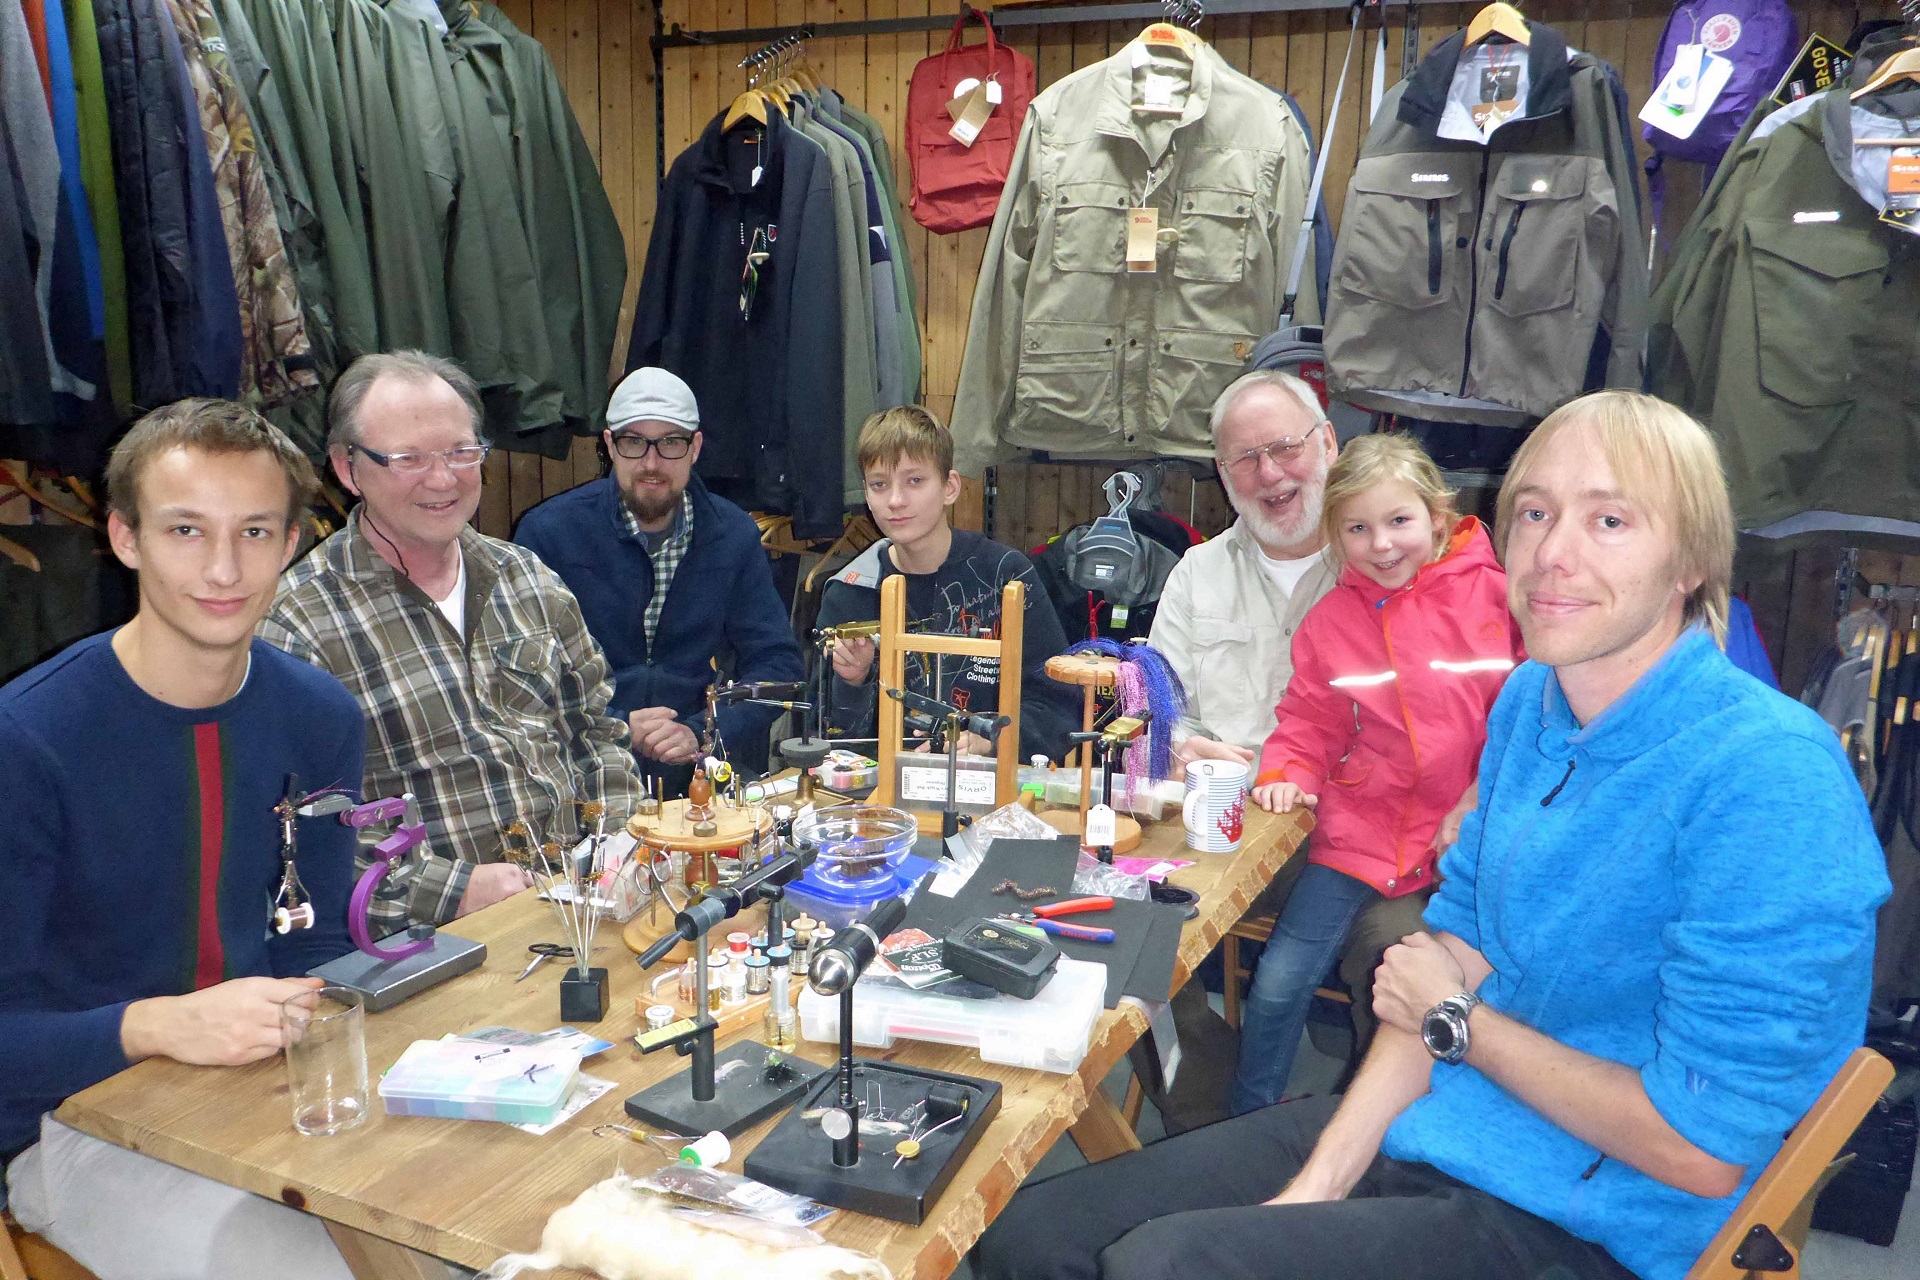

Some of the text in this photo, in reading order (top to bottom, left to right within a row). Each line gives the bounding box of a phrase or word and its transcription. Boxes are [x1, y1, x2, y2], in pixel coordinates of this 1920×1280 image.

[1811, 46, 1832, 88] GORE
[966, 671, 996, 685] Clothing
[958, 784, 987, 793] ORVIS
[911, 947, 939, 962] SLF
